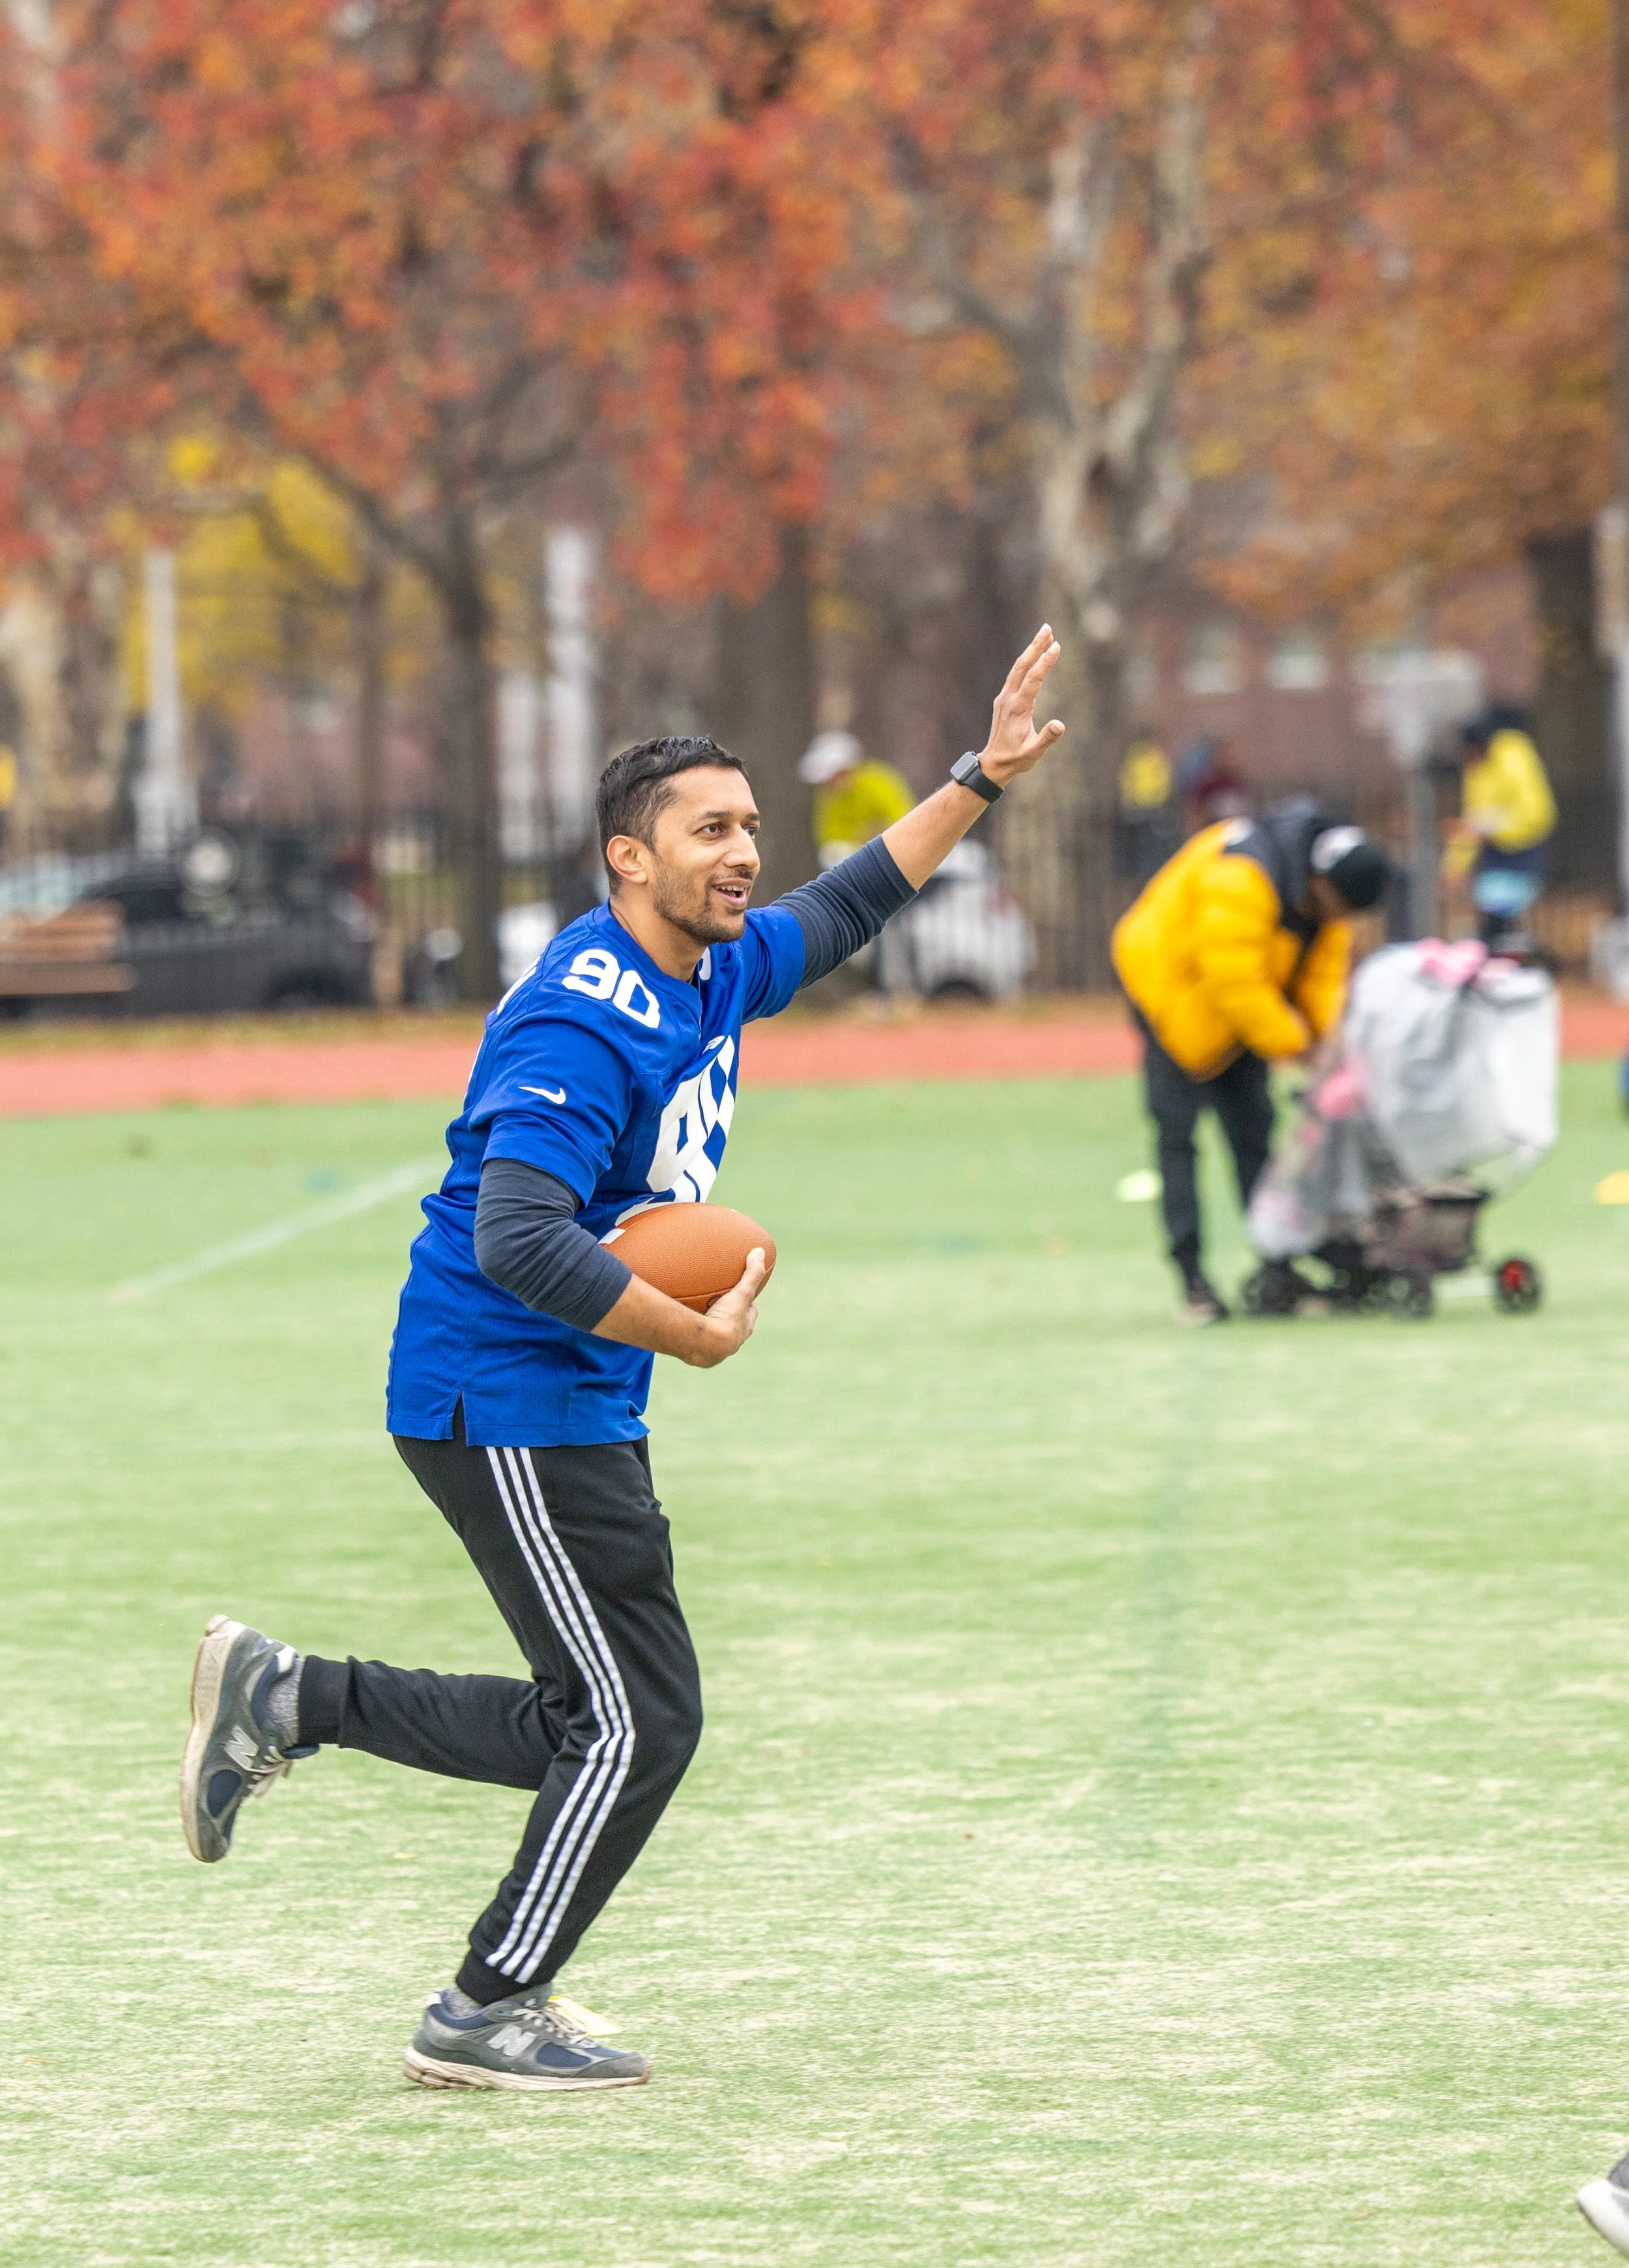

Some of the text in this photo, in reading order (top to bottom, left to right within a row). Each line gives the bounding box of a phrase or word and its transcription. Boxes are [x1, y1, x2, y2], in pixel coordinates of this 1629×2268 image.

[561, 949, 661, 1029] 90
[224, 1725, 259, 1770] N
[486, 2024, 537, 2057] N
